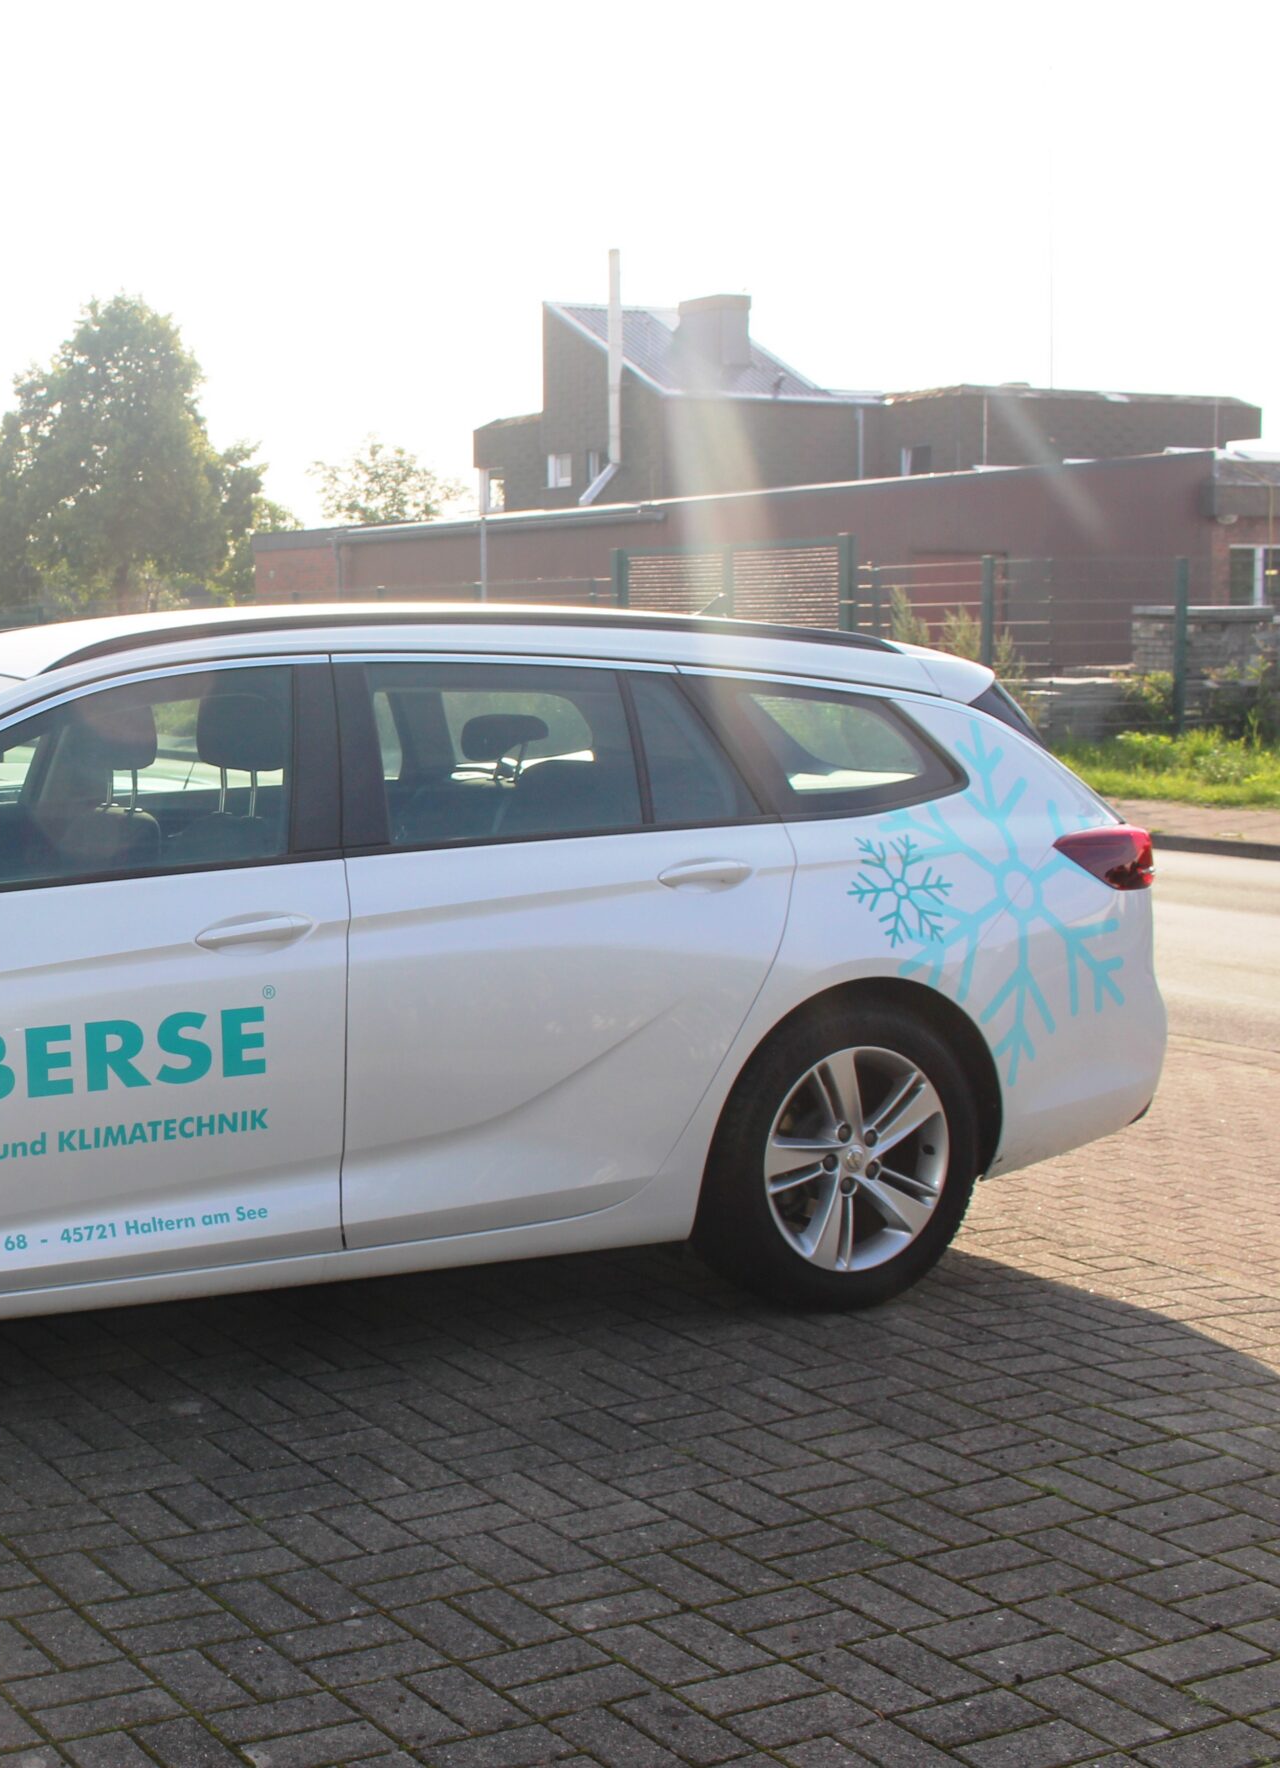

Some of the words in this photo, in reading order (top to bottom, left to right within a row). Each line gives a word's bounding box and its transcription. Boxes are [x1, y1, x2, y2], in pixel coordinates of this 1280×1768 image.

[57, 1108, 268, 1153] KLIMATECHNIK
[4, 1234, 29, 1252] 68
[60, 1222, 118, 1244] 45721
[125, 1216, 196, 1238] Haltern
[201, 1211, 231, 1227] am
[236, 1205, 269, 1222] See
